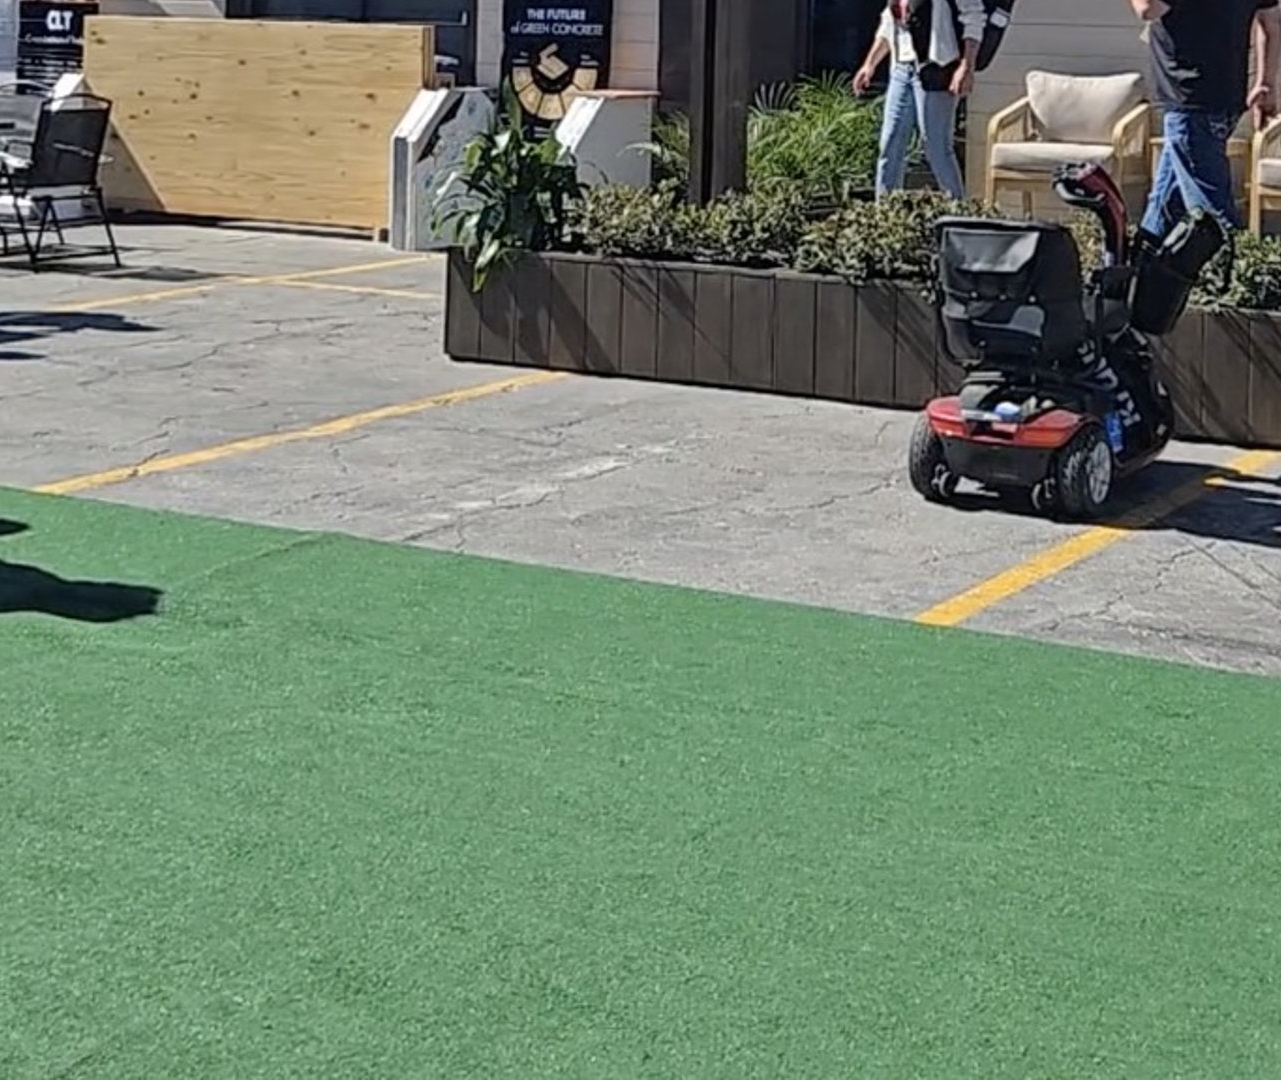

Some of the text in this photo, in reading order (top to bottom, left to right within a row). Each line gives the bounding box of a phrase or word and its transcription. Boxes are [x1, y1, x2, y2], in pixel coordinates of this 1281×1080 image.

[46, 9, 74, 31] CLT
[527, 8, 587, 21] THE FUTURE
[552, 23, 604, 35] CONCRETE
